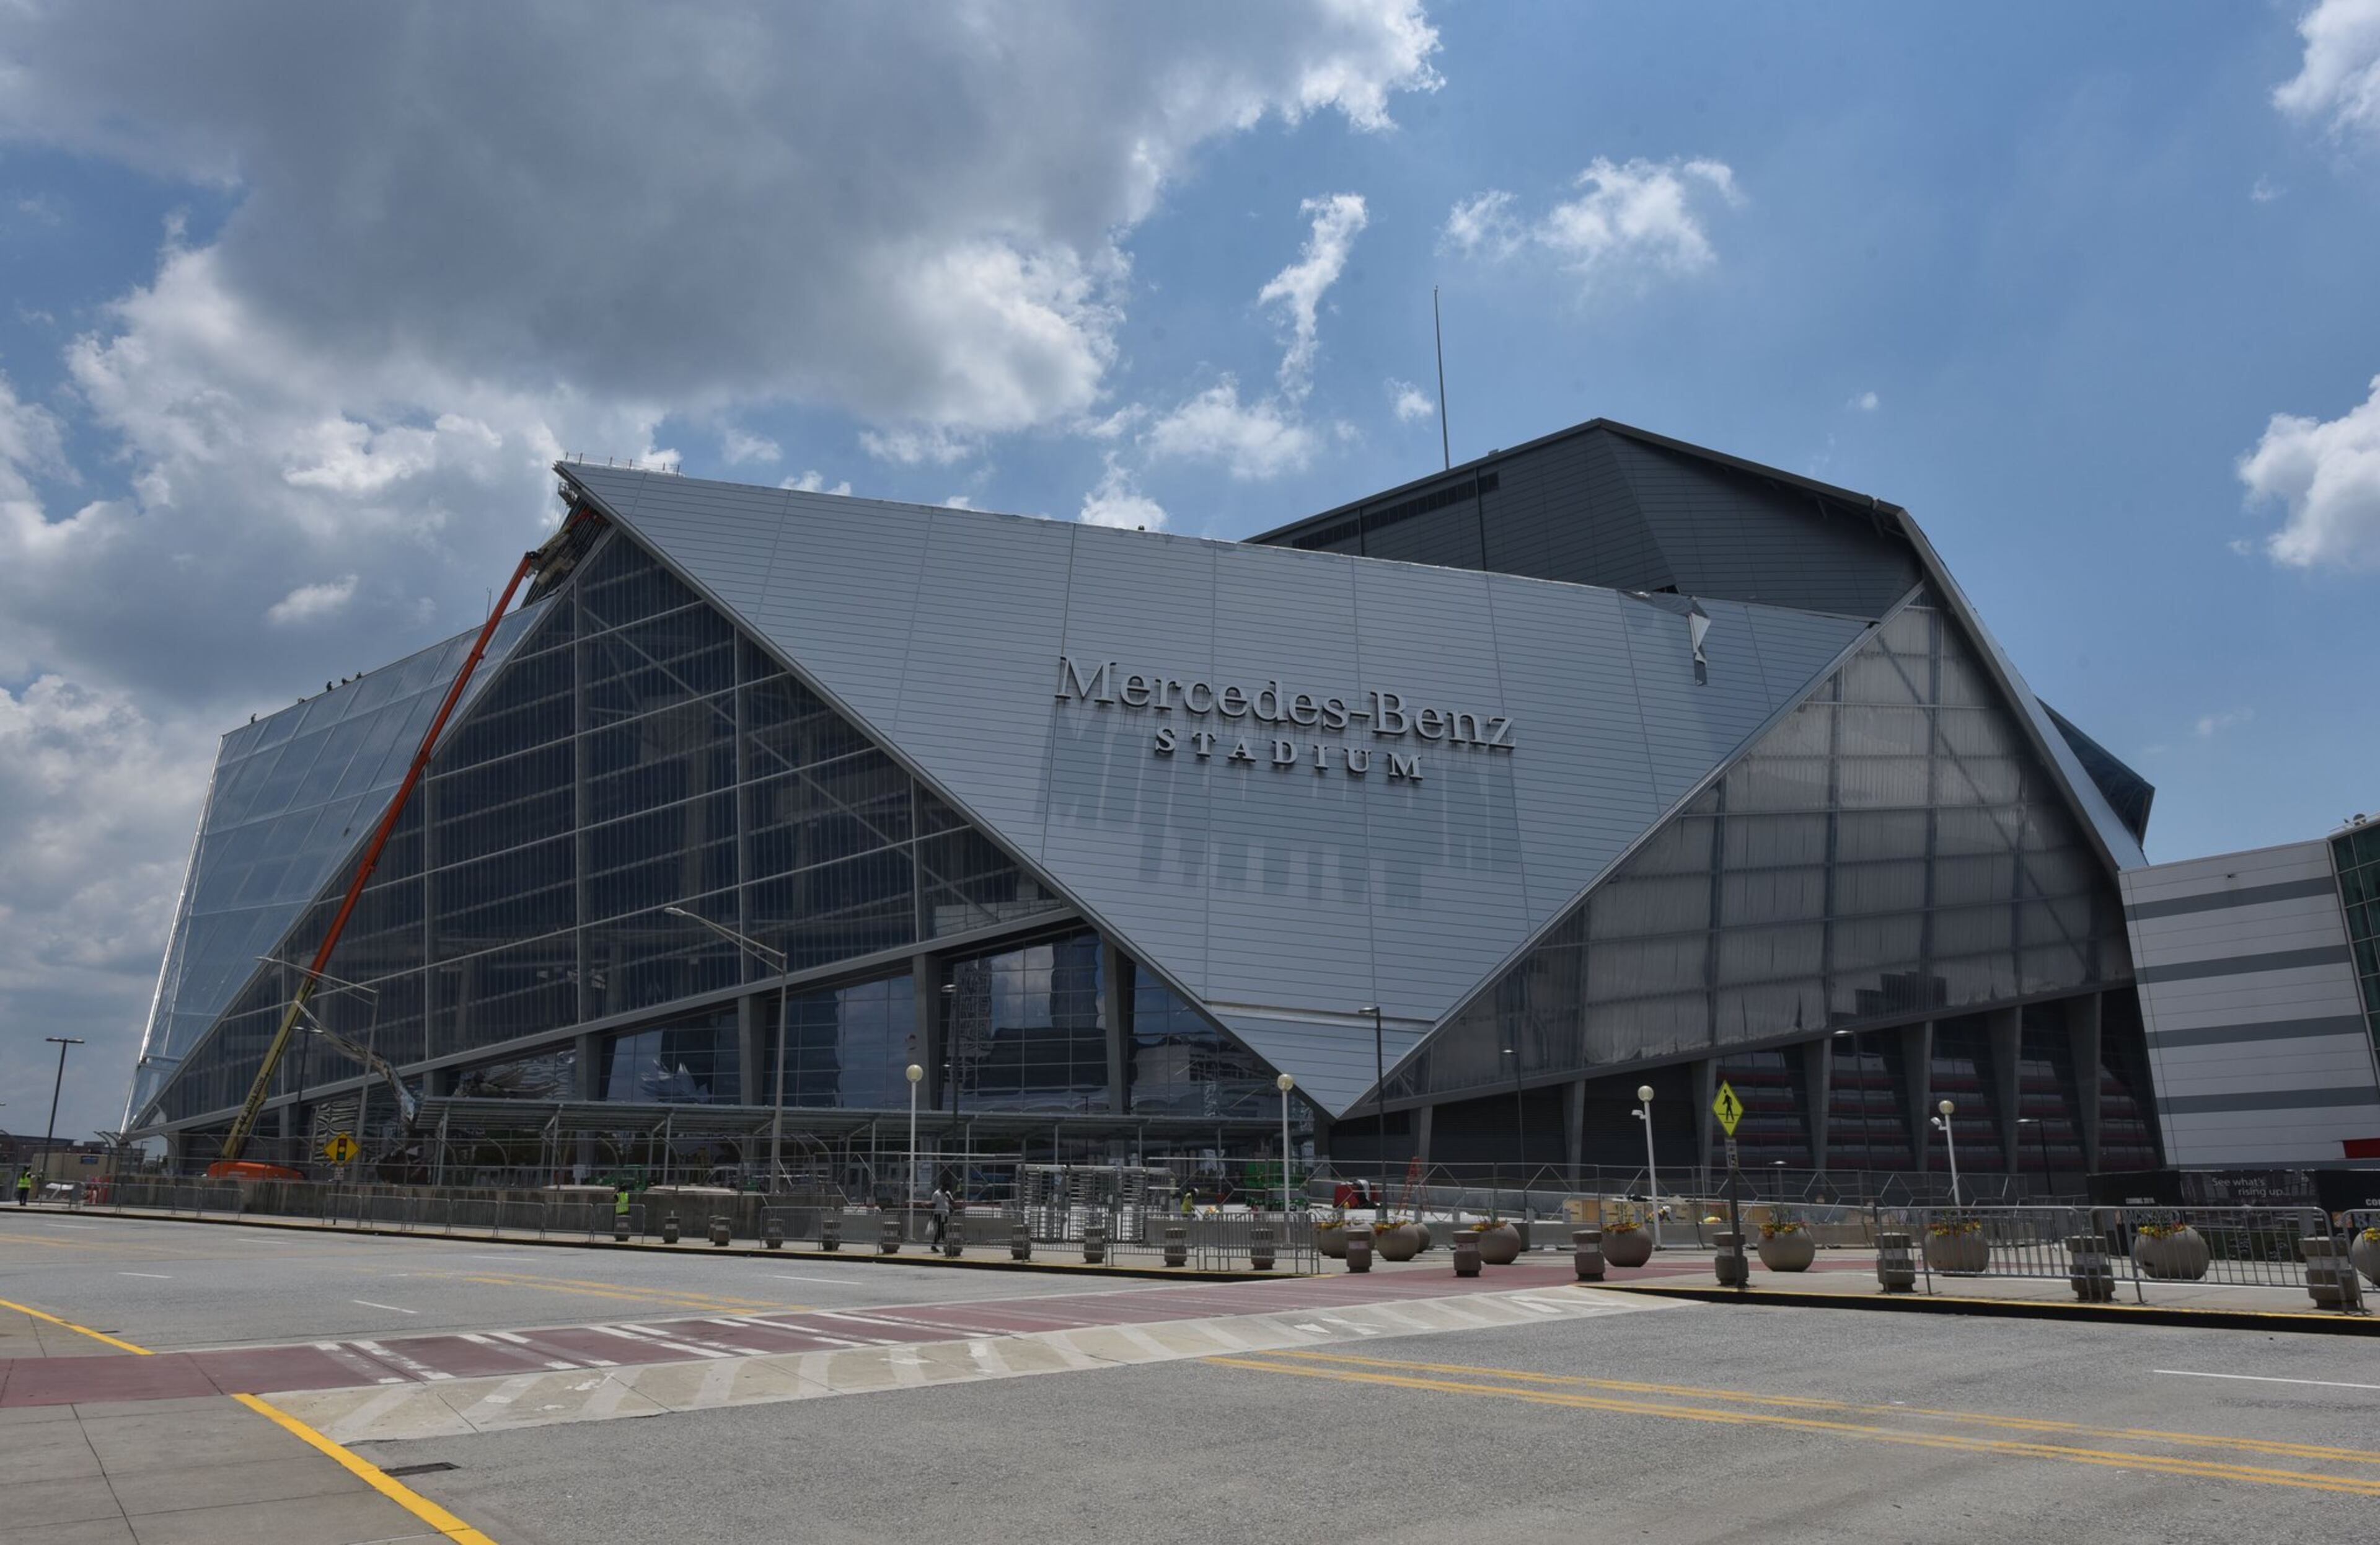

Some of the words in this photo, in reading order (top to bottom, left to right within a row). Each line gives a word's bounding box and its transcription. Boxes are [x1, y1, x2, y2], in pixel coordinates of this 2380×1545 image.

[1055, 655, 1516, 750] Mercedes-Benz
[1155, 724, 1423, 781] STADIUM
[2211, 1177, 2231, 1186] See
[2232, 1177, 2265, 1186] what's
[2238, 1187, 2267, 1198] rising
